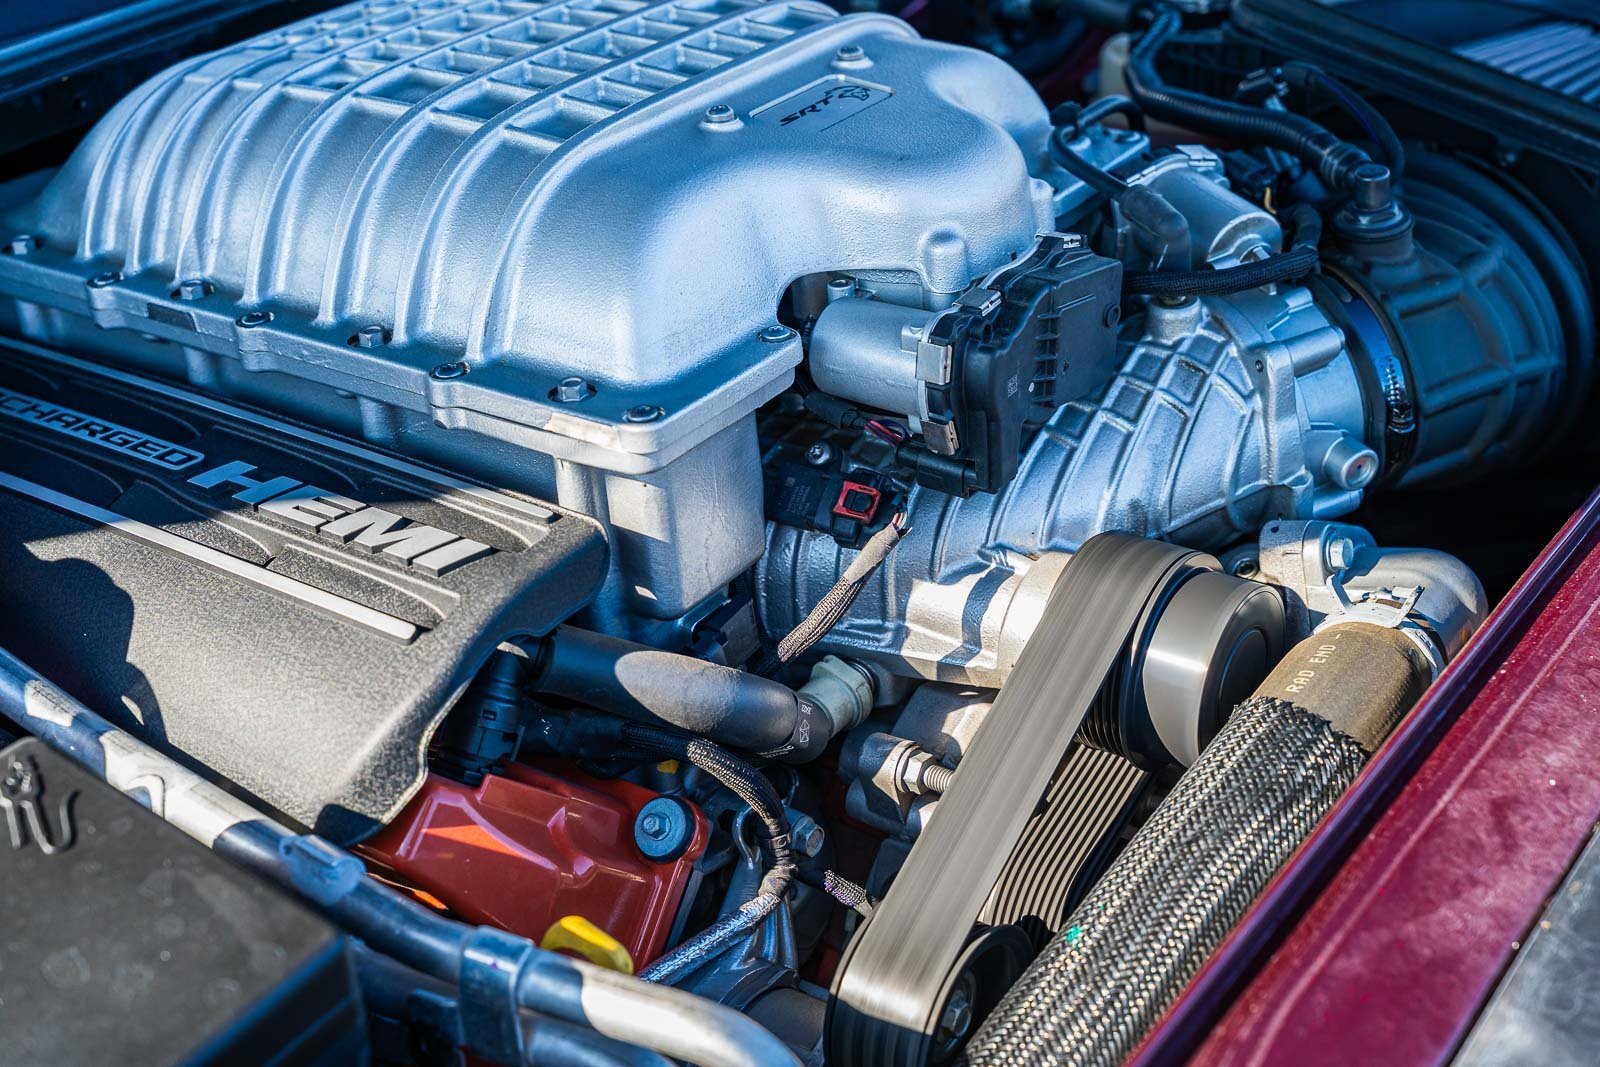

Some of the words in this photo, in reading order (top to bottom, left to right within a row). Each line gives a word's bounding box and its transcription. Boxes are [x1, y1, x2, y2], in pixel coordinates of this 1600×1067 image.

[780, 95, 834, 126] SRT
[0, 392, 199, 467] CHARGED
[187, 460, 494, 575] HEMI
[1285, 670, 1315, 693] RAD
[1308, 645, 1337, 664] END
